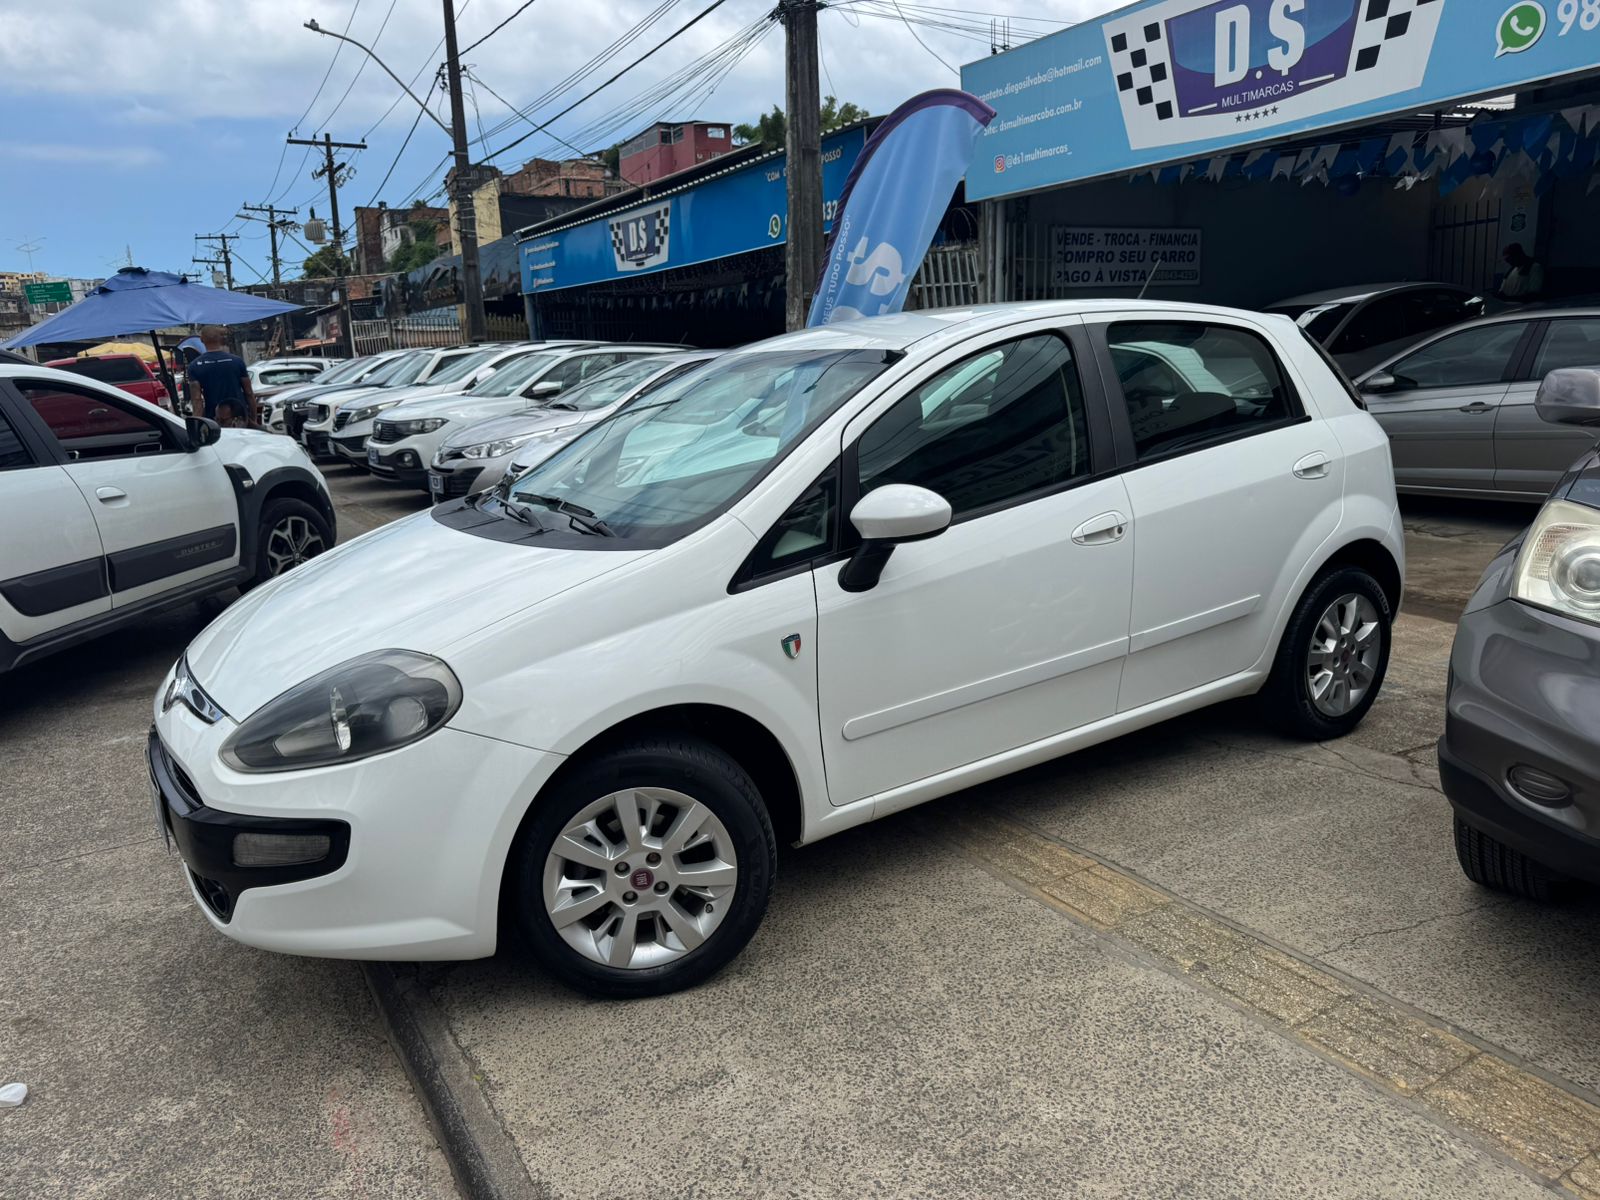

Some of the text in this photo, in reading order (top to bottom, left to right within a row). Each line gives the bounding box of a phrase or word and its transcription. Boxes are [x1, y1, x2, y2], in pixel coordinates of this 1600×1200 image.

[1221, 80, 1294, 108] MULTIMARCAS
[1057, 232, 1095, 246] VENDE
[1104, 232, 1140, 246] TROCA
[1149, 232, 1198, 246] FINANCIA
[1119, 250, 1146, 263] SEU
[1151, 250, 1196, 263] CARRO
[828, 263, 841, 296] TUDO
[1109, 270, 1147, 283] VISTA
[636, 873, 648, 886] FIAT
